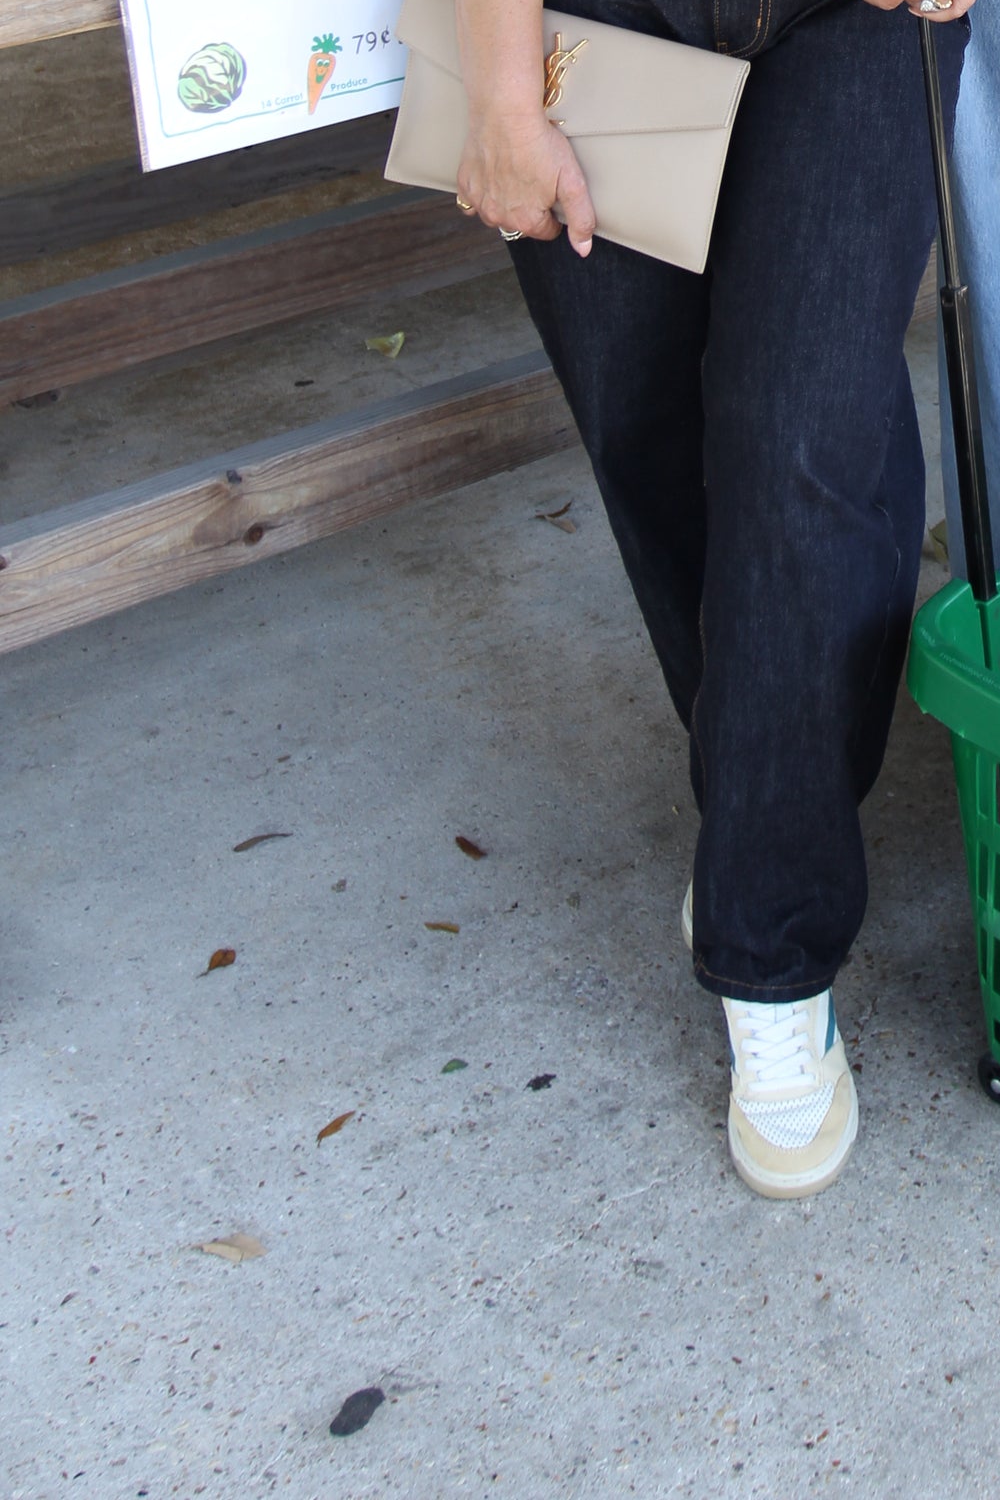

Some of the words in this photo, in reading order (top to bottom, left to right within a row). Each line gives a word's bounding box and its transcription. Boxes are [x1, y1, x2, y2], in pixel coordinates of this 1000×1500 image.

[352, 25, 391, 55] 79¢
[274, 92, 304, 106] Carrot
[330, 77, 368, 92] Produce
